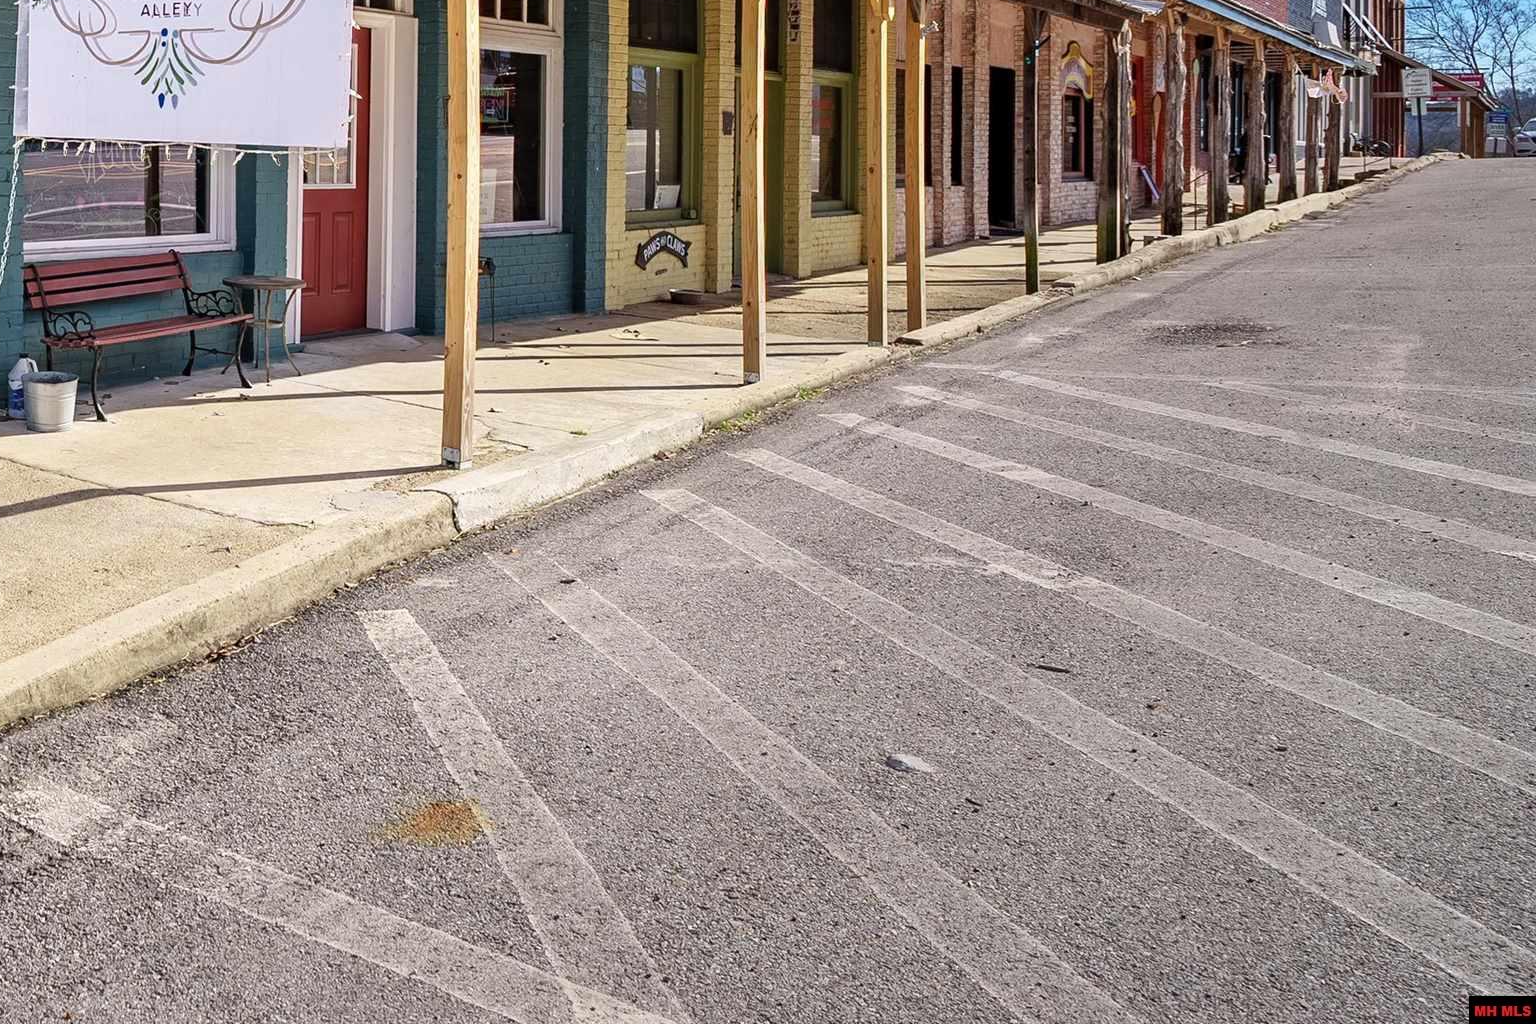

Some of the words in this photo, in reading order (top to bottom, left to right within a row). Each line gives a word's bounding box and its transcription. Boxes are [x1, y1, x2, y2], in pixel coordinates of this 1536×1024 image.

[141, 2, 195, 17] ALLEY
[643, 237, 661, 262] PAWS
[666, 234, 686, 257] CLAWS
